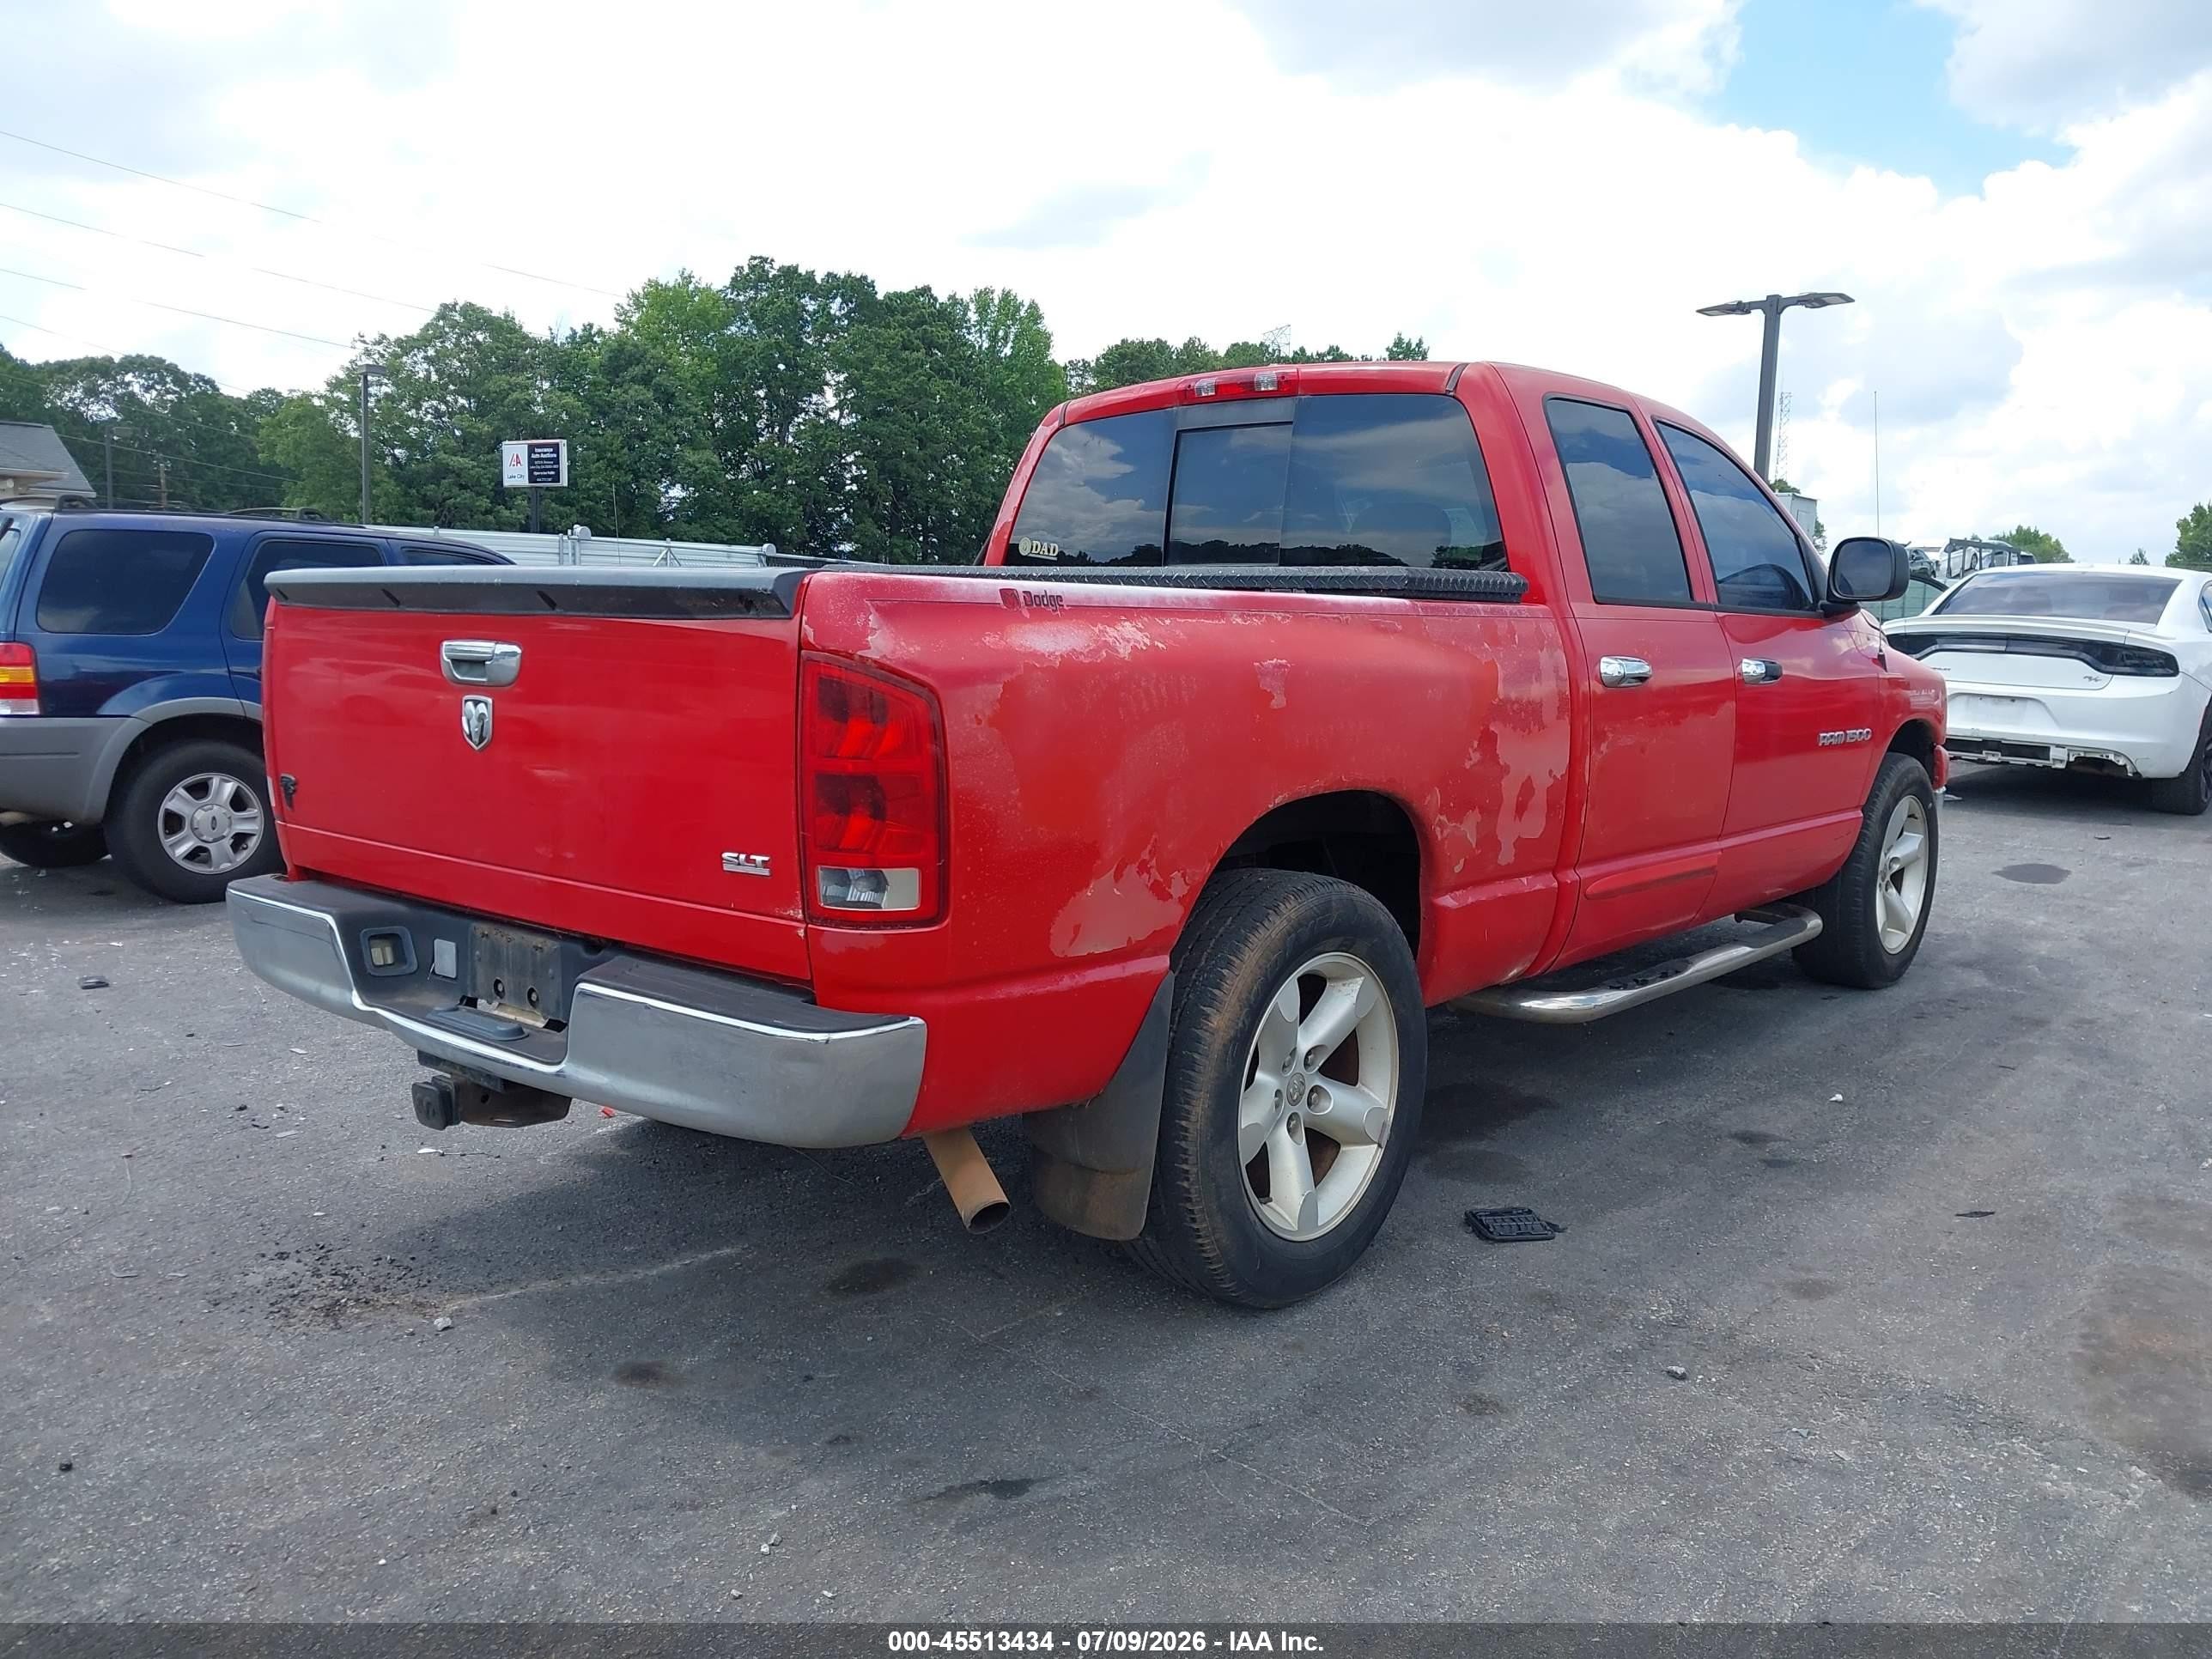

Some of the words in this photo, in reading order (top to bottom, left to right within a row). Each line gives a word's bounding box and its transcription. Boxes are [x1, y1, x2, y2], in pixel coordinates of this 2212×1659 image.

[1031, 540, 1059, 556] DAD
[1022, 590, 1064, 612] Dodge
[1818, 731, 1845, 747] RAM
[1845, 728, 1872, 743] 1500
[721, 851, 770, 869] SLT
